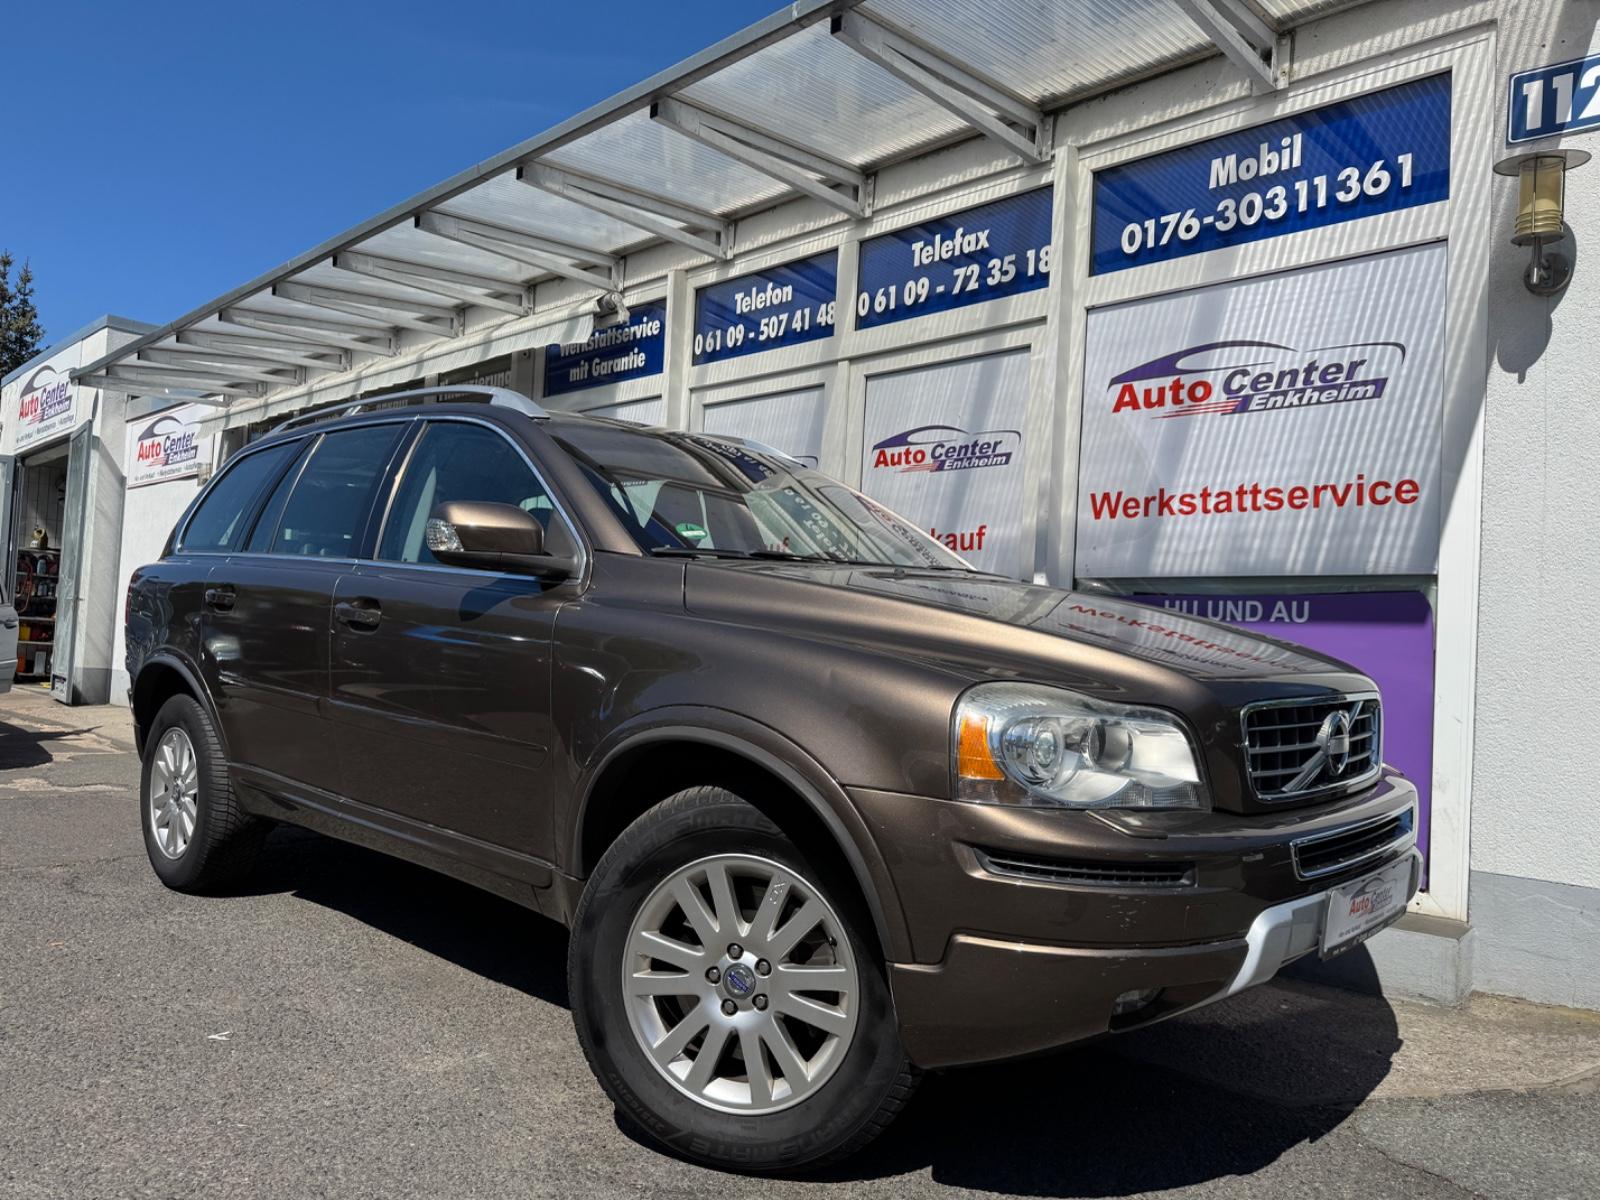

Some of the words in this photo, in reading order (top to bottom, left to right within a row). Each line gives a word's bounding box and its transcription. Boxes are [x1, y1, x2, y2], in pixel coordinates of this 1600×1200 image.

[1523, 65, 1600, 130] 112
[1209, 133, 1302, 190] Mobil
[912, 227, 990, 267] Telefax
[735, 282, 793, 315] Telefon
[759, 312, 789, 341] 507
[570, 361, 588, 382] mit
[592, 347, 646, 376] Garantie
[1112, 376, 1212, 413] Auto
[1223, 359, 1367, 396] Center
[1248, 383, 1376, 411] Enkheim
[19, 394, 39, 420] Auto
[138, 440, 161, 461] Auto
[164, 432, 195, 453] Center
[874, 447, 926, 468] Auto
[930, 439, 1003, 460] Center
[943, 454, 1007, 471] Enkheim
[1090, 474, 1420, 520] Werkstattservice
[1207, 600, 1264, 622] UND
[1269, 600, 1310, 623] AU
[1349, 896, 1370, 916] Auto
